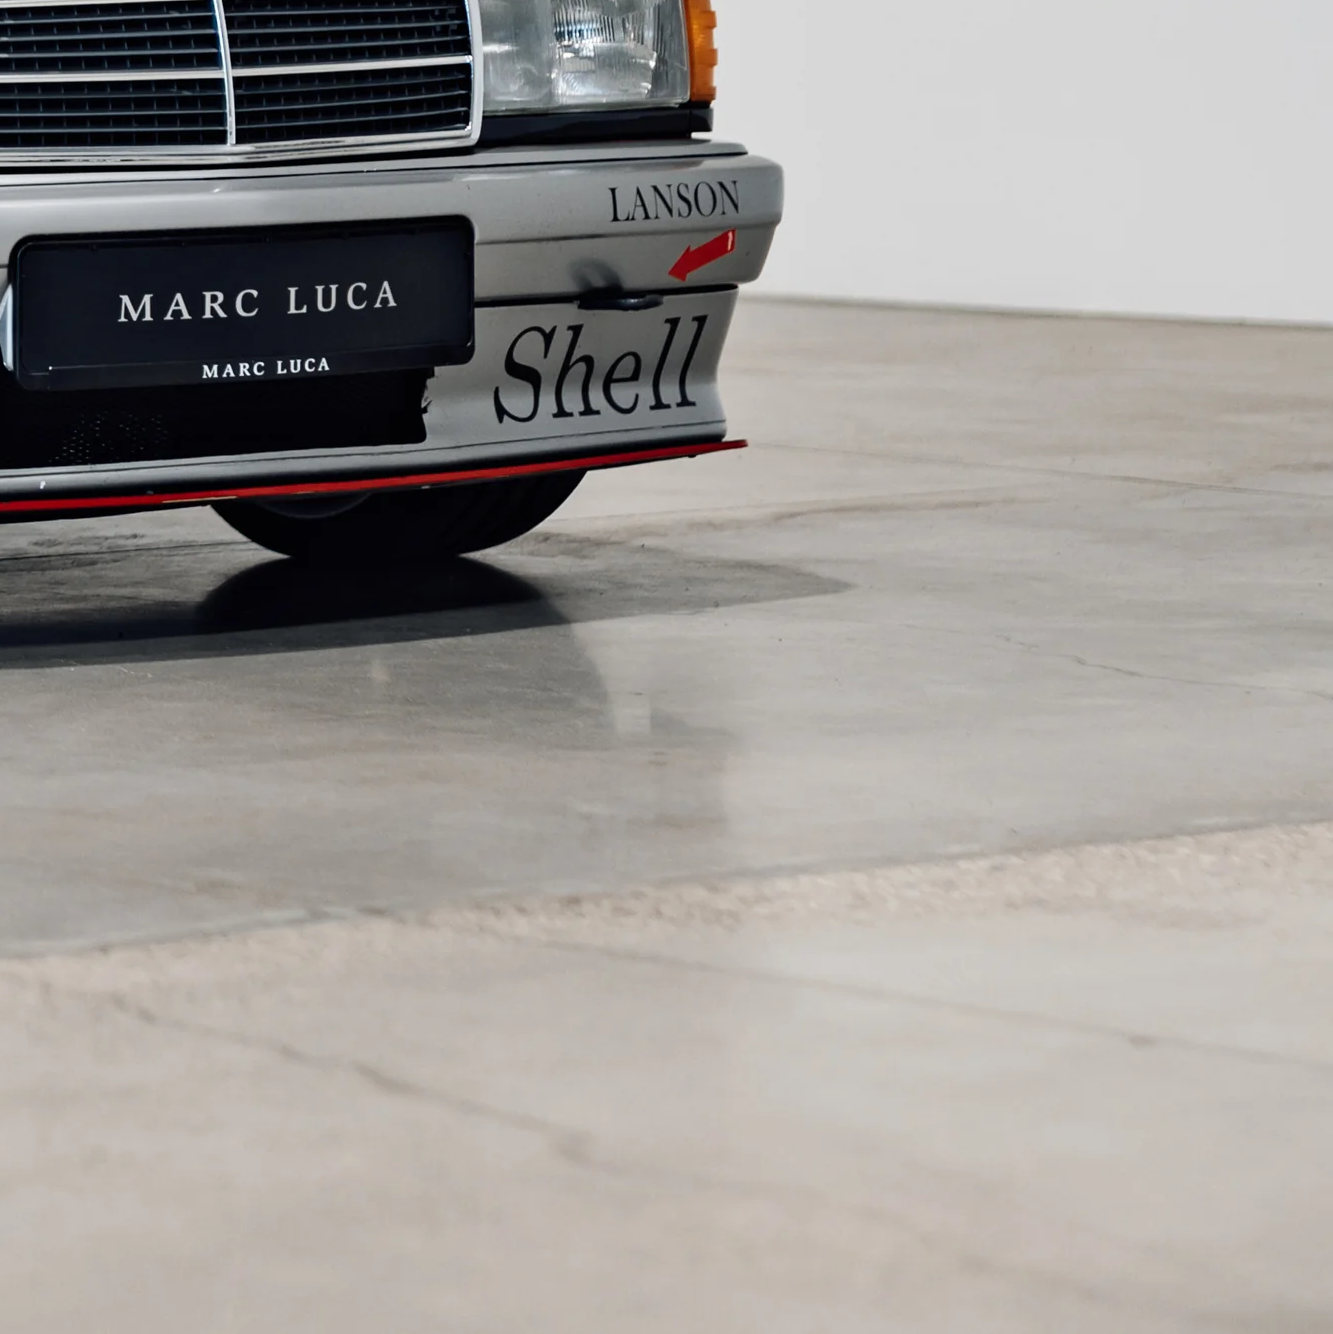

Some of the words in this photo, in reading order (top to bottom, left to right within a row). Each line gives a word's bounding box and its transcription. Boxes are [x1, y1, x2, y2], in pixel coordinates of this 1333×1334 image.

[608, 179, 741, 223] LANSON
[117, 288, 260, 322] MARC
[287, 280, 398, 315] LUCA
[201, 361, 265, 379] MARC
[276, 357, 331, 375] LUCA
[493, 314, 709, 424] Shell
